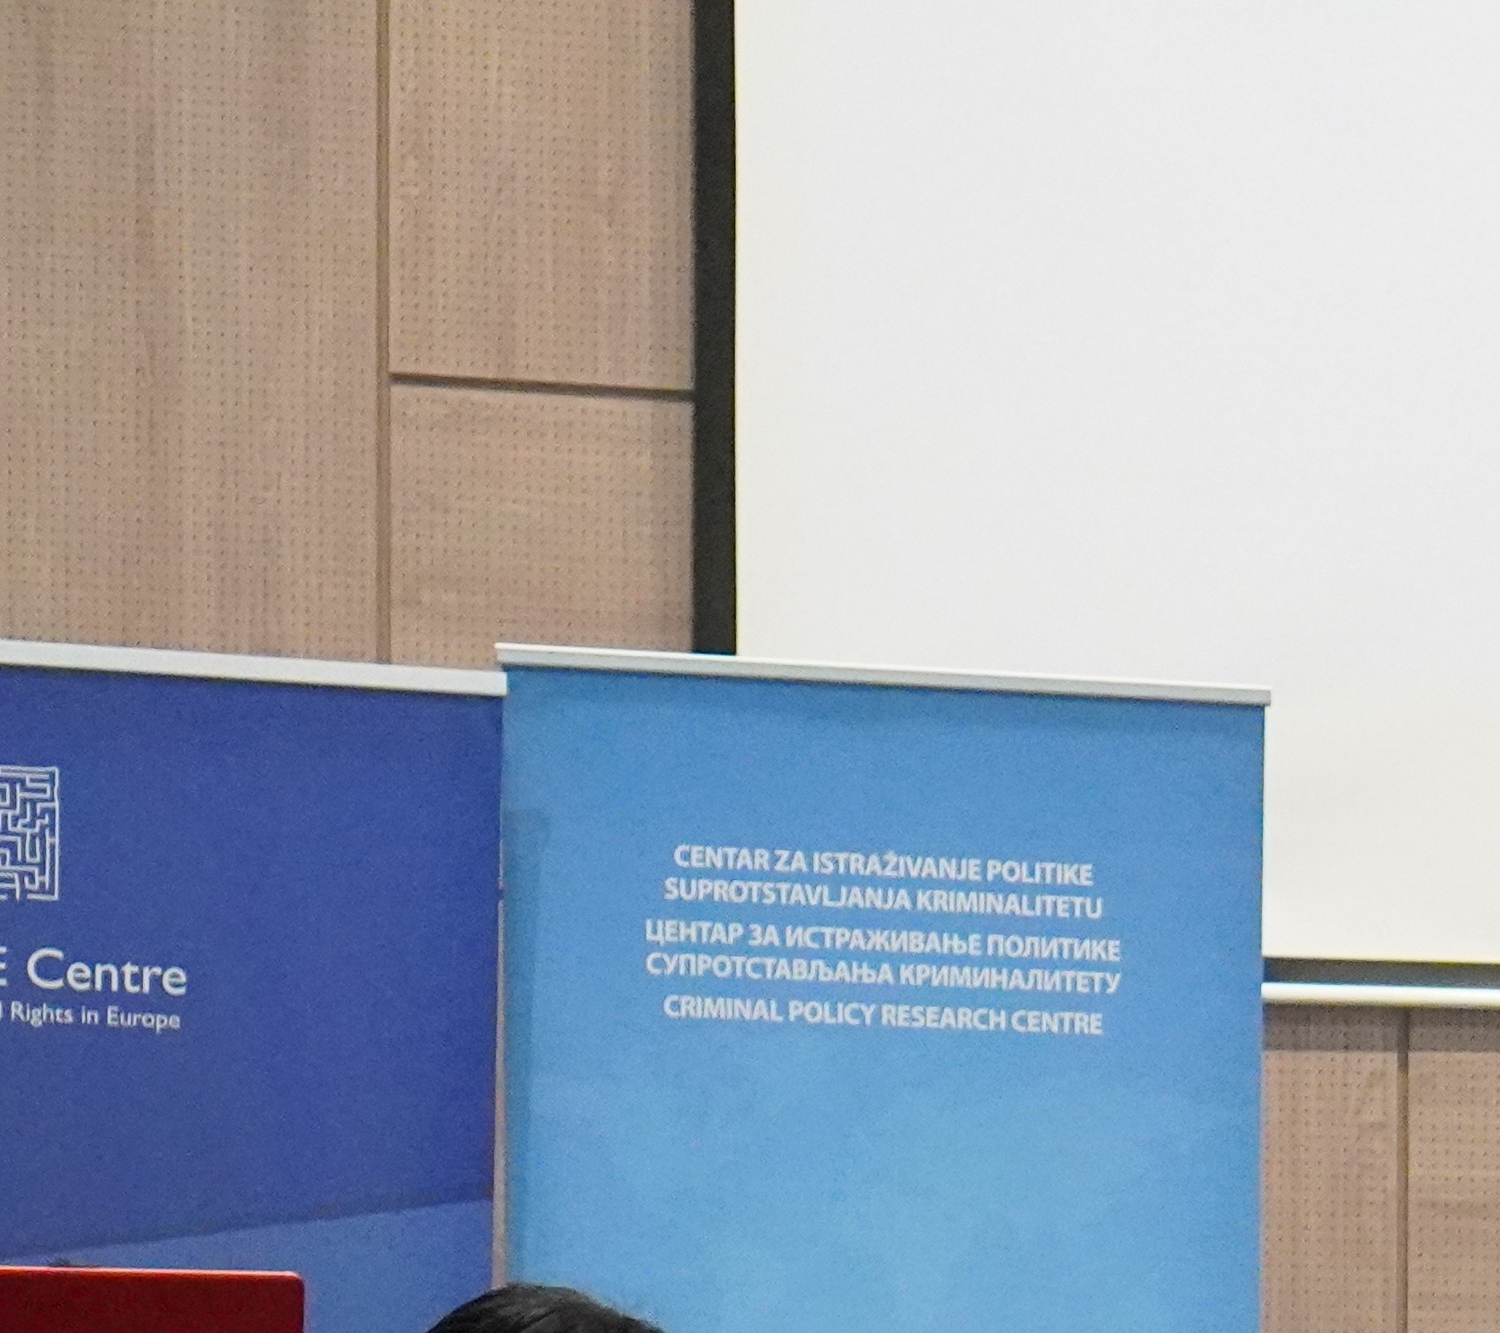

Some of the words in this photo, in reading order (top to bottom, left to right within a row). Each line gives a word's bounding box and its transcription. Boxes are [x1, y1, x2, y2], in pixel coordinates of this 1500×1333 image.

[673, 843, 771, 871] CENTAR
[773, 849, 805, 873] ZA
[812, 850, 982, 882] ISTRAŽIVANJE
[986, 859, 1094, 887] POLITIKE
[664, 876, 913, 911] SUPROTSTAVLJANJA
[916, 889, 1103, 920] KRIMINALITETU
[645, 918, 745, 947] ЦЕНТАР
[748, 923, 781, 947] ЗА
[785, 925, 982, 957] ИСТРАЖИВАЊЕ
[986, 933, 1121, 962] ПОЛИТИКЕ
[26, 947, 187, 996] Centre
[646, 951, 895, 985] СУПРОТСТАВЉАЊА
[899, 963, 1122, 994] КРИМИНАЛИТЕТУ
[10, 1000, 74, 1028] Rights
[81, 1006, 100, 1025] in
[106, 1005, 181, 1034] Europe
[663, 994, 784, 1023] CRIMINAL
[788, 999, 877, 1026] POLICY
[881, 1003, 1007, 1031] RESEARCH
[1010, 1009, 1103, 1036] CENTRE
